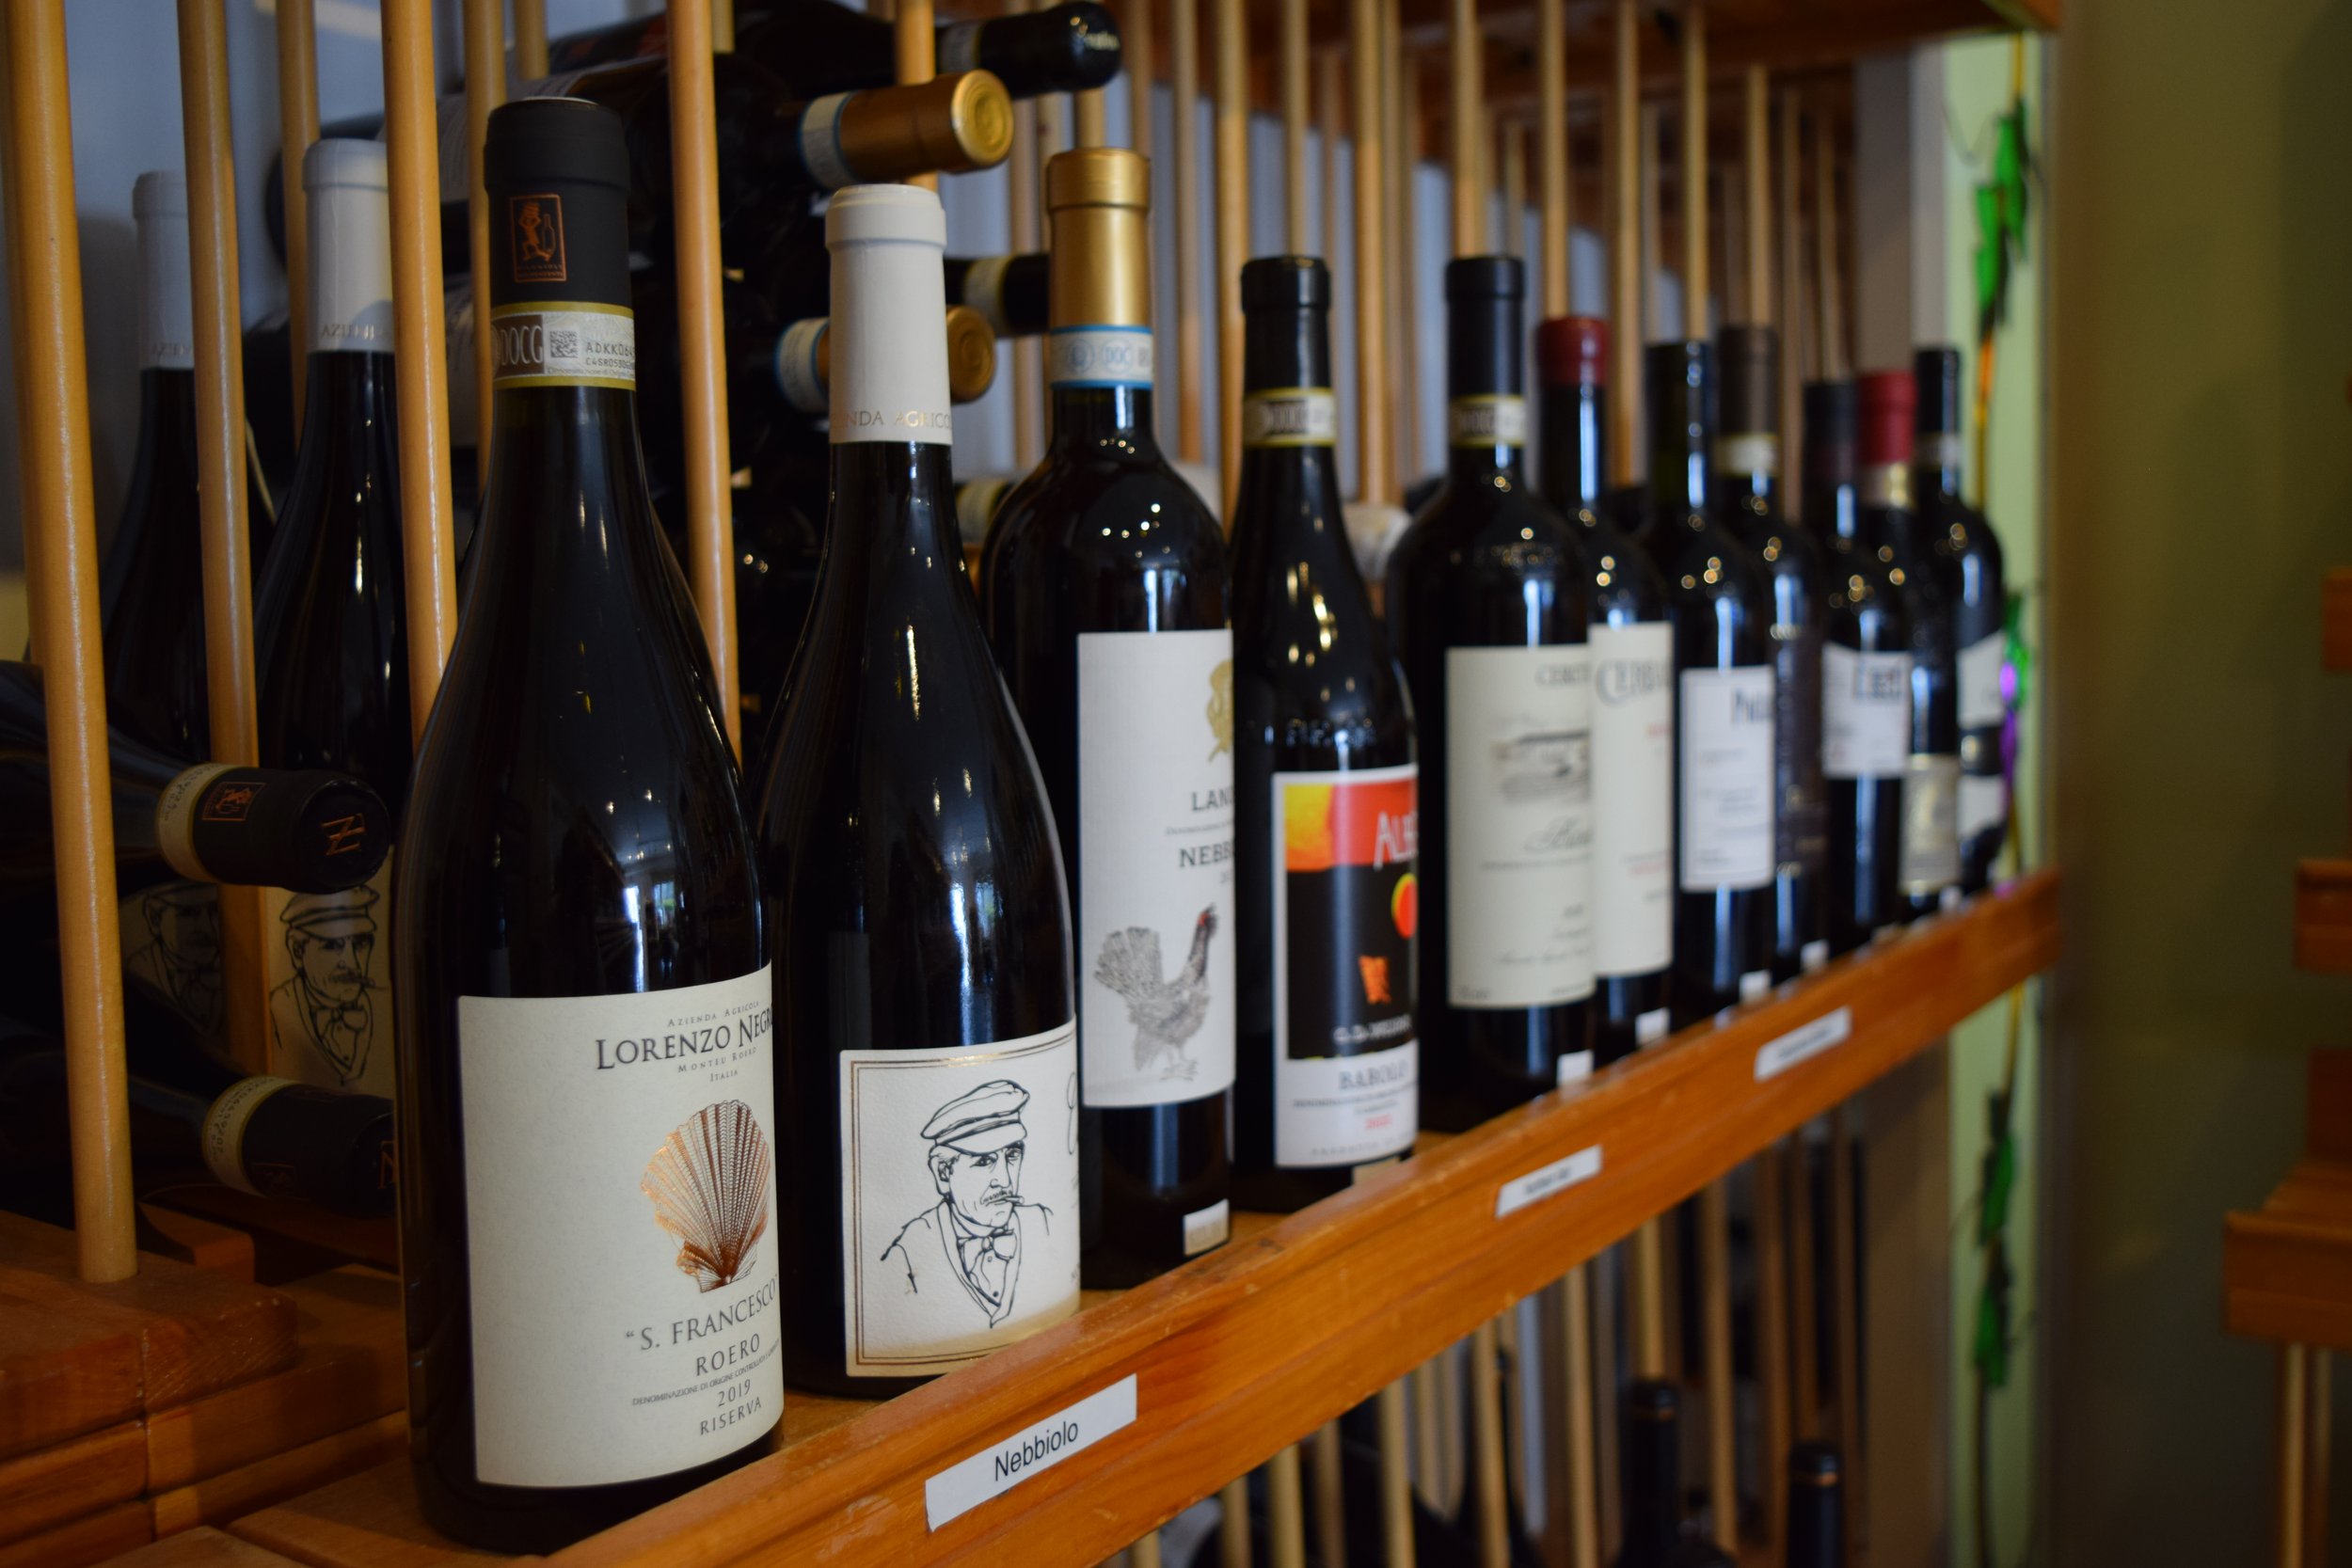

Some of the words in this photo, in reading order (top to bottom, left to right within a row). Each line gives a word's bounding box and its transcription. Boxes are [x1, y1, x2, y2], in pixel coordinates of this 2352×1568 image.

[667, 1013, 717, 1028] AZIENDA
[596, 1025, 731, 1070] LORENZO
[676, 1056, 727, 1073] MONTEU
[710, 1069, 739, 1083] ITALIA
[696, 1333, 760, 1376] ROERO
[632, 1385, 699, 1406] DENOMINAZIONE
[700, 1382, 708, 1391] DI
[709, 1372, 734, 1387] ORIGINE
[718, 1379, 751, 1407] 2019
[699, 1396, 762, 1436] RISERVA
[993, 1421, 1079, 1481] Nebbiolo
